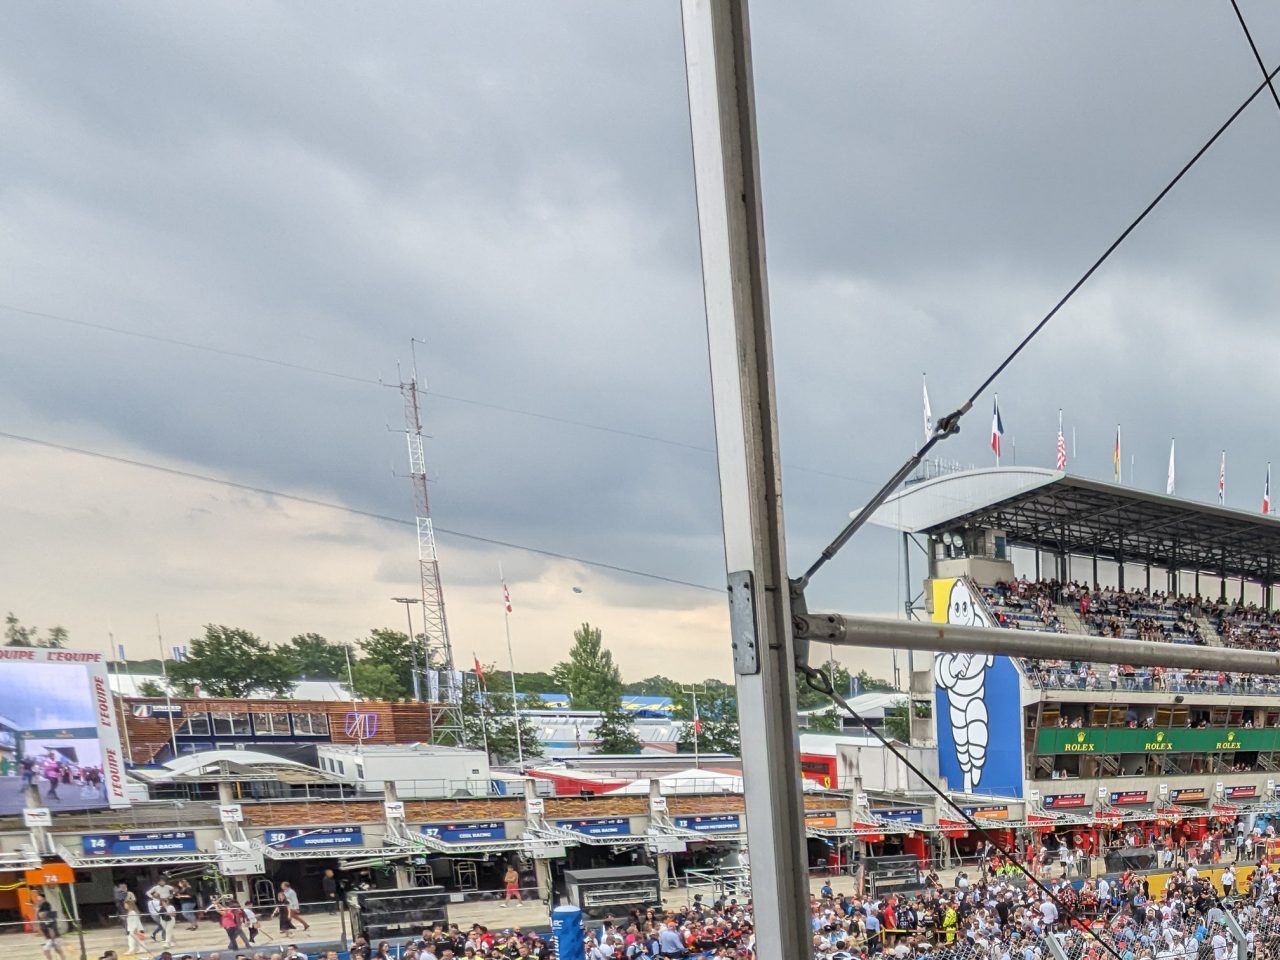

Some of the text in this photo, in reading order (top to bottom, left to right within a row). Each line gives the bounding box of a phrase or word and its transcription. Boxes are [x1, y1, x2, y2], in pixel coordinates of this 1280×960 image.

[1065, 743, 1094, 751] ROLEX
[1145, 742, 1173, 750] ROLEX
[270, 832, 286, 842] 30
[90, 839, 106, 848] 14
[254, 863, 263, 873] 14
